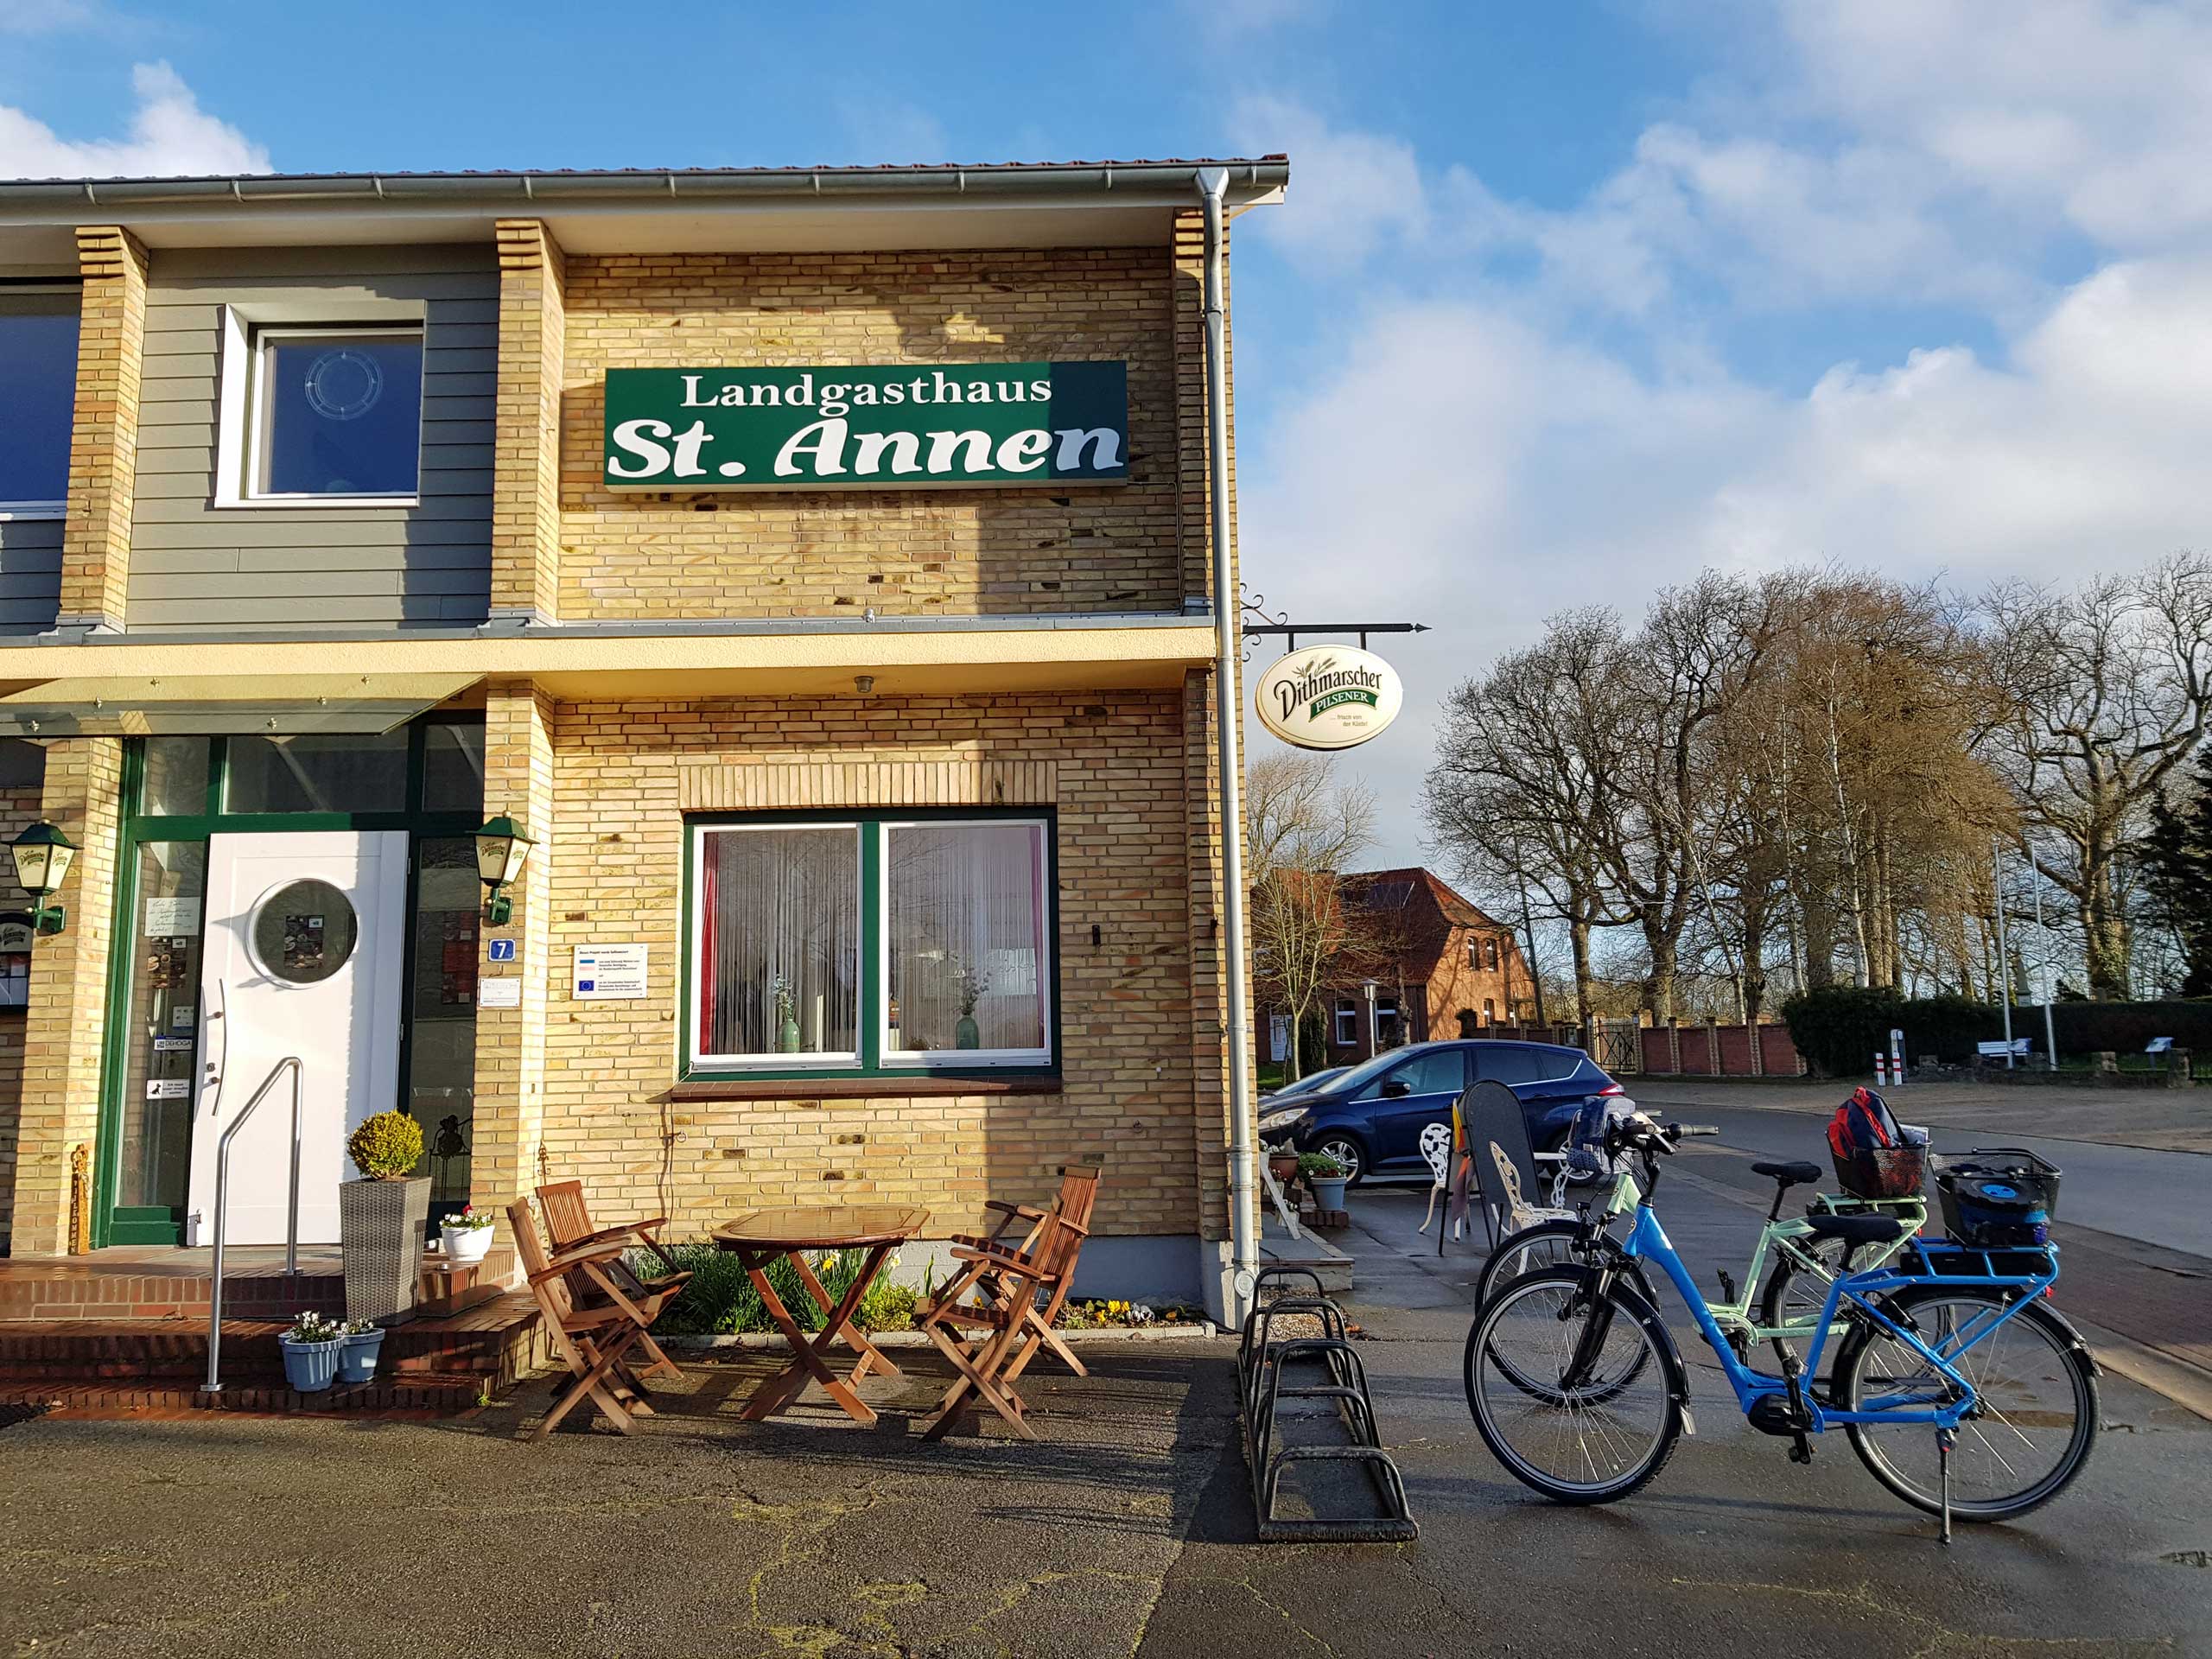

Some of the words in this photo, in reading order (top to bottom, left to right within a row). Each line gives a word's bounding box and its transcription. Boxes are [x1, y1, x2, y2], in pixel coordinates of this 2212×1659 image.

[679, 372, 1052, 417] Landgasthaus
[607, 418, 747, 478] St.
[773, 416, 1124, 477] Annen
[1273, 664, 1382, 722] Dithmarscher
[1315, 691, 1369, 713] PILSENER
[498, 942, 507, 959] 7
